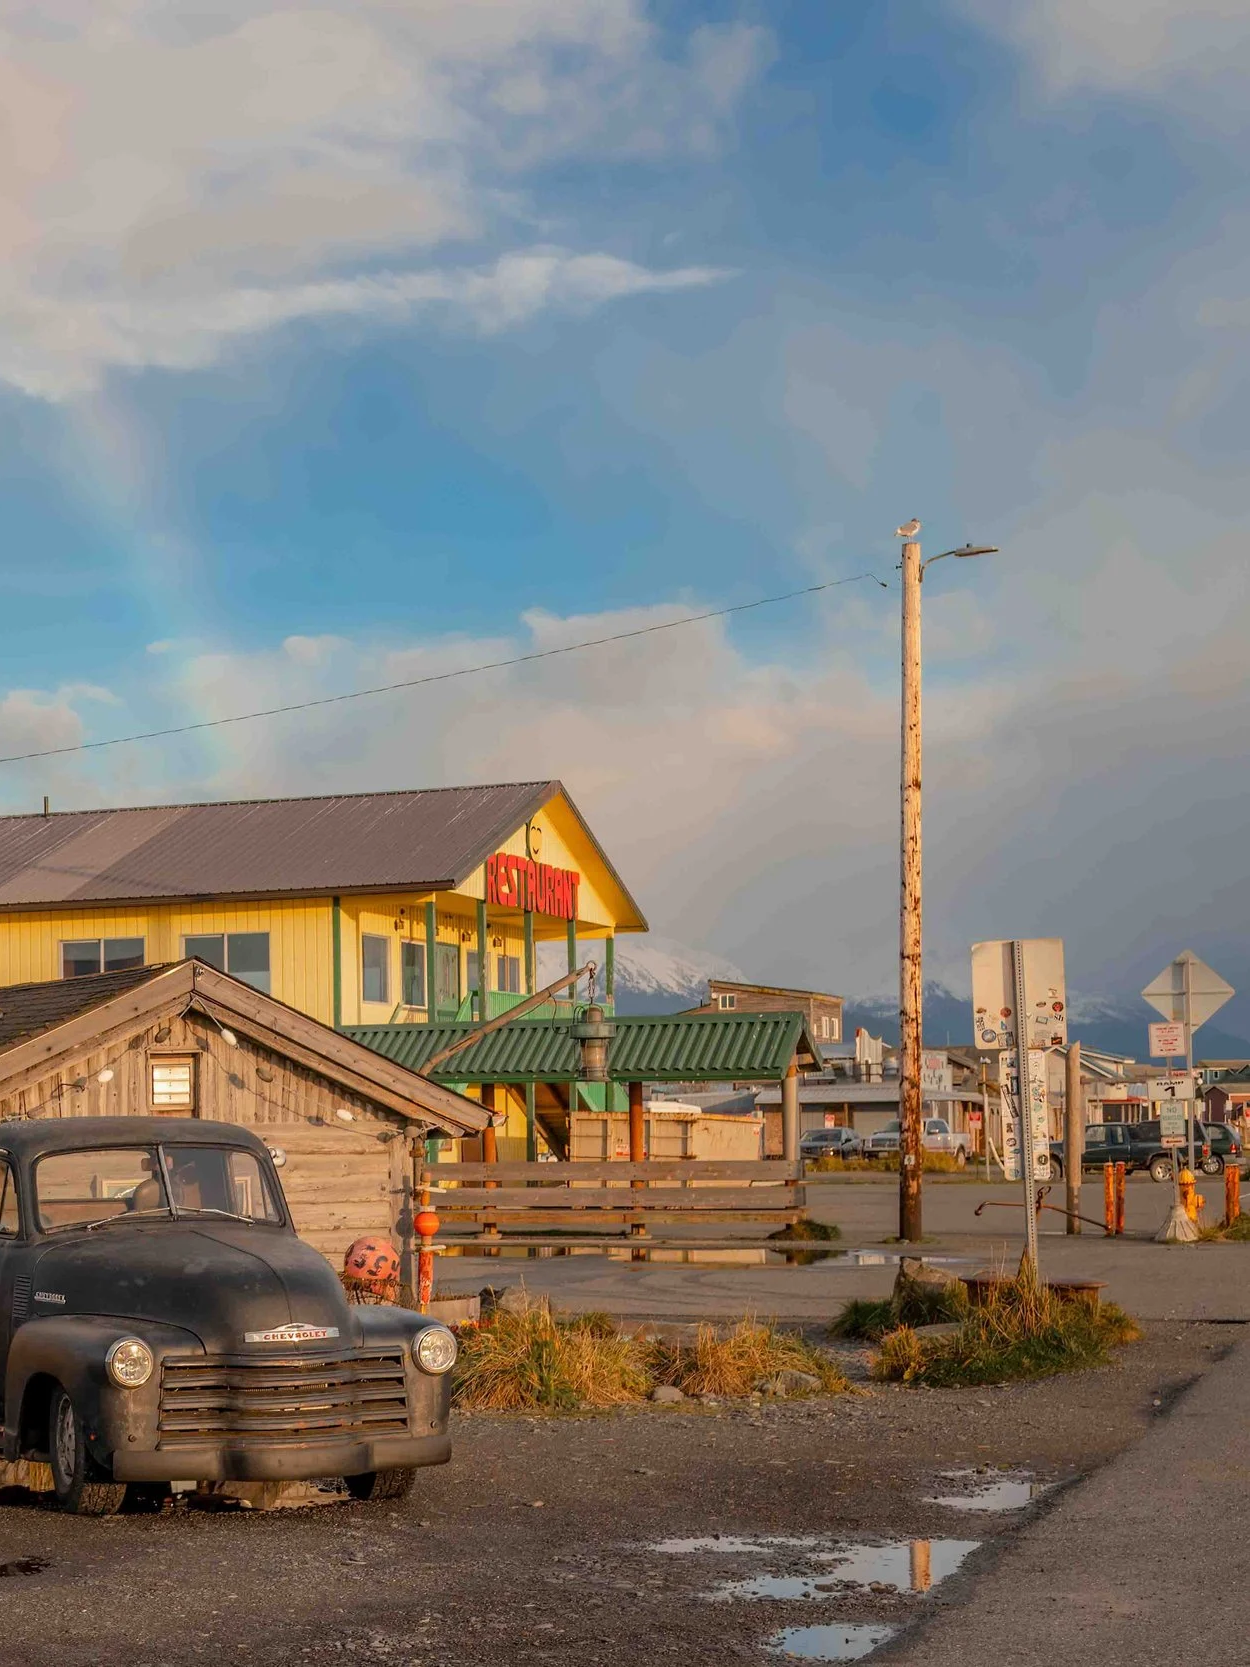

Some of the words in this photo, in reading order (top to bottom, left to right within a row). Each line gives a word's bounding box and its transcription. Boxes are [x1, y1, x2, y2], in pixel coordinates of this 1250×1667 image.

[487, 852, 579, 920] RESTAURANT
[1164, 1086, 1176, 1097] 1
[263, 1331, 327, 1341] CHEVROLET
